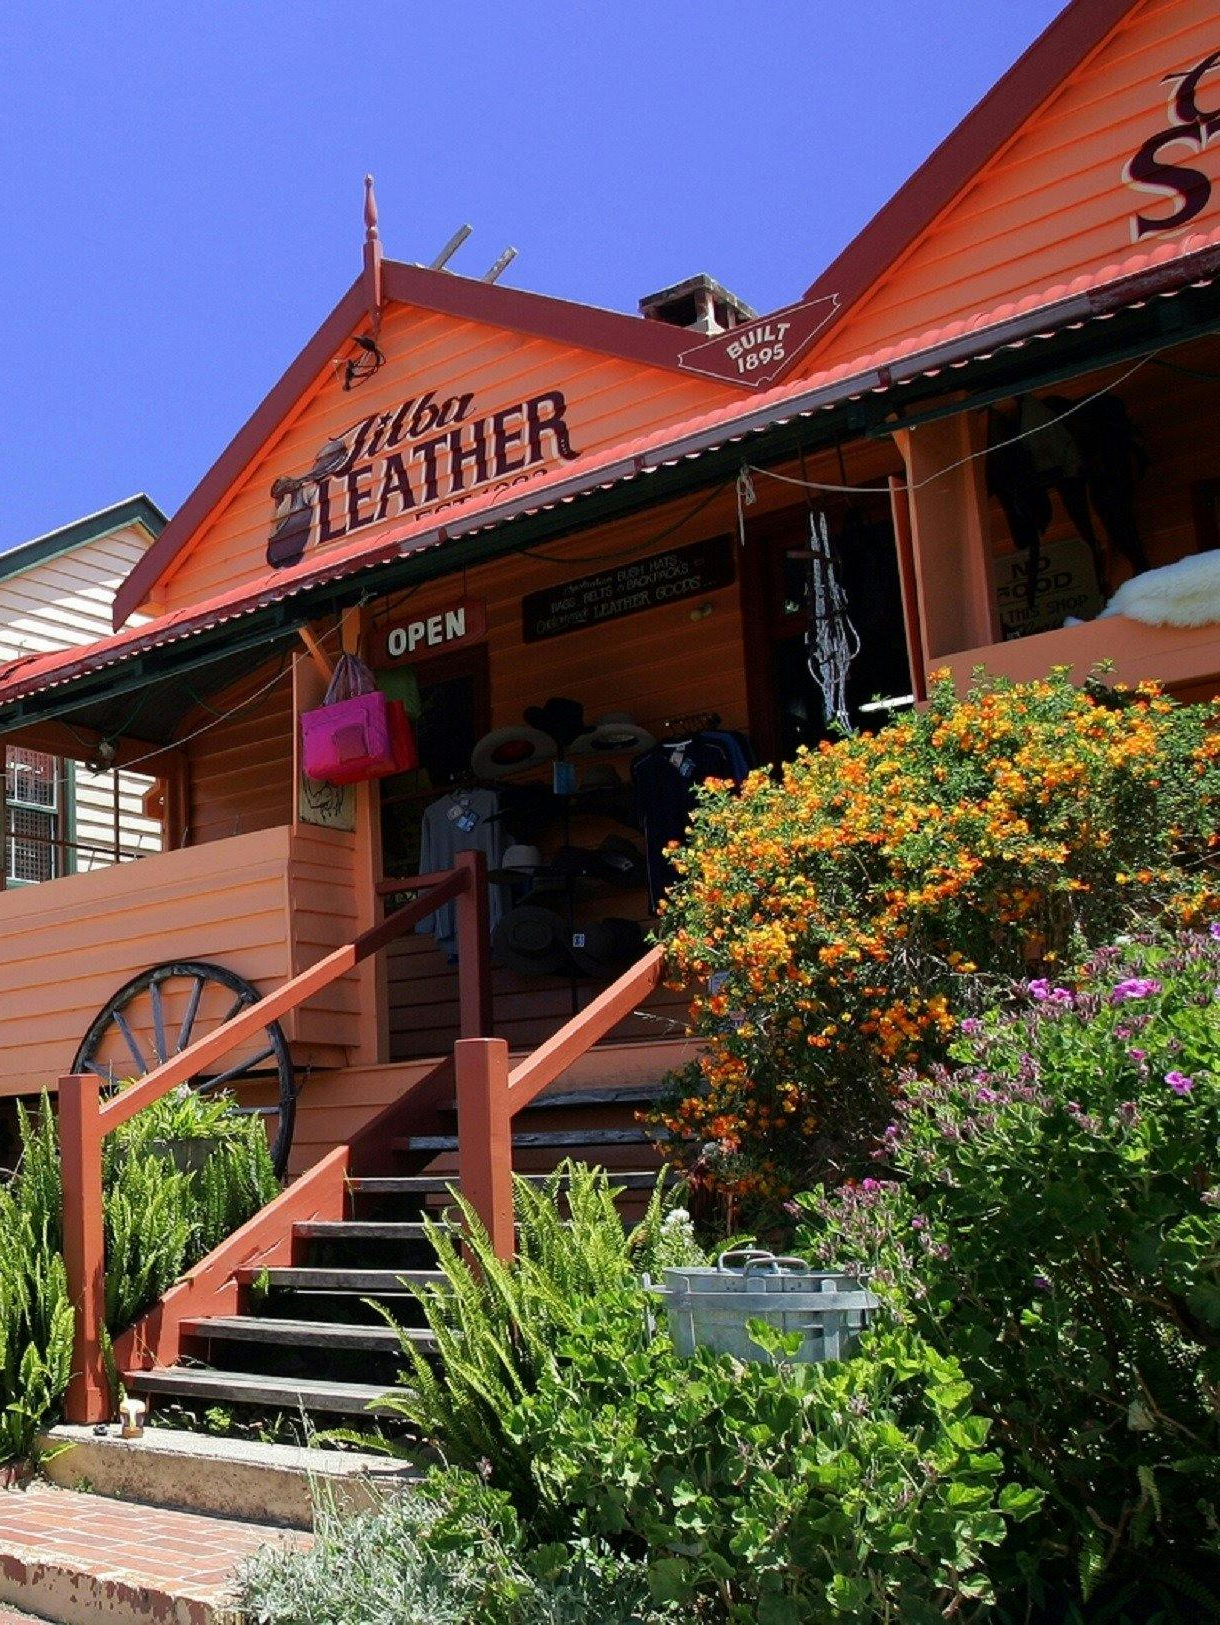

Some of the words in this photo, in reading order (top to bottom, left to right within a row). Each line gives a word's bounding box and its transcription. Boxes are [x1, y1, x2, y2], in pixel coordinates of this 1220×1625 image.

[1122, 122, 1220, 244] S
[726, 323, 790, 359] BUILT
[736, 342, 785, 374] 1895
[330, 390, 477, 477] Tilba
[314, 390, 582, 545] LEATHER
[593, 592, 650, 618] LEATHER
[388, 607, 466, 656] OPEN
